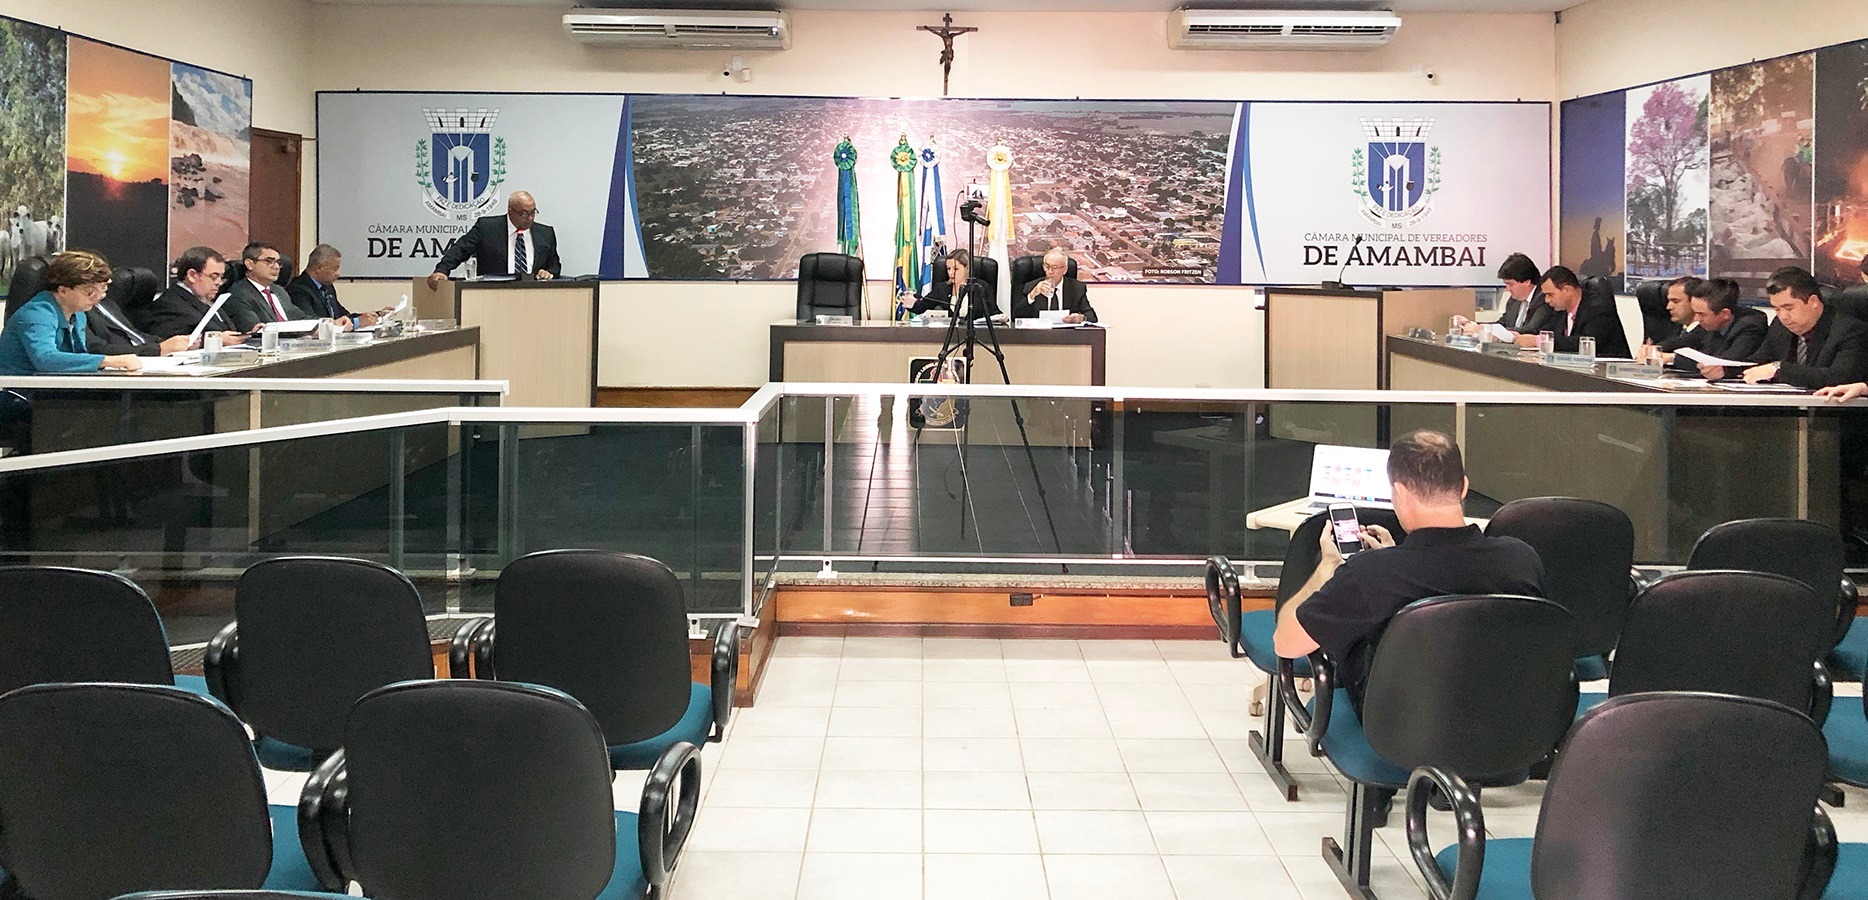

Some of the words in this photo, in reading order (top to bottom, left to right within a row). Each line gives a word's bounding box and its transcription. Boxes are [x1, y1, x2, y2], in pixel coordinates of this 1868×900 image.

[368, 223, 413, 234] CÂMARA
[1304, 233, 1349, 242] CÂMARA
[1351, 234, 1404, 242] MUNICIPAL
[1408, 234, 1421, 242] DE
[1422, 234, 1487, 243] VEREADORES
[367, 237, 402, 258] DE
[1303, 245, 1338, 266] DE
[1344, 245, 1486, 267] AMAMBAI
